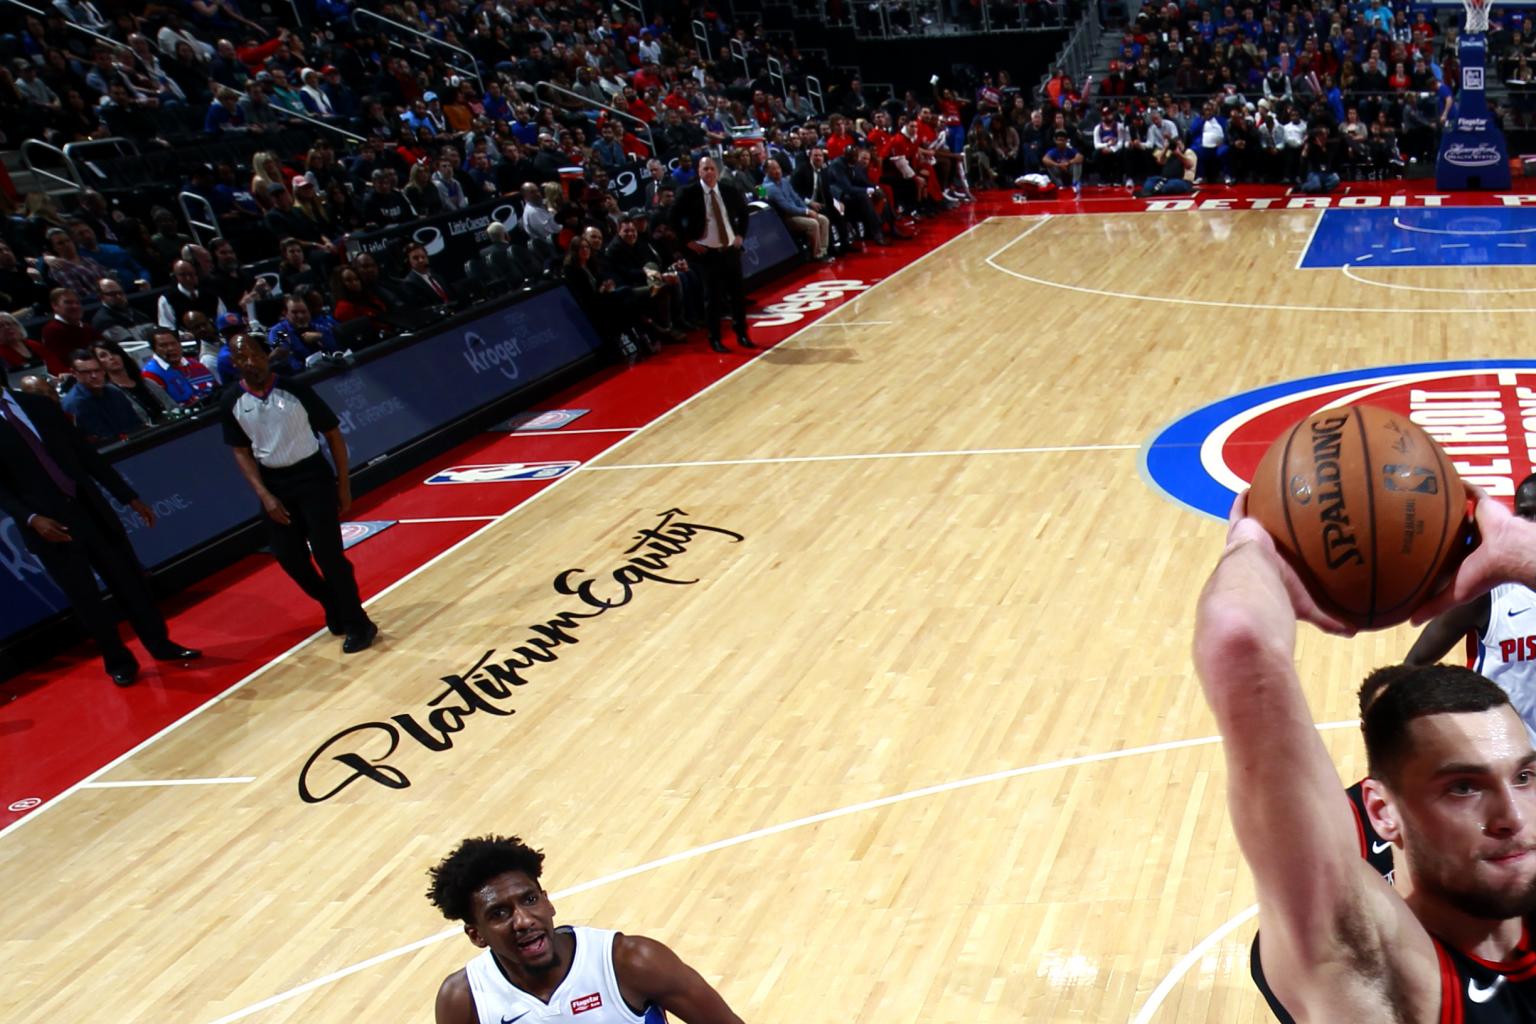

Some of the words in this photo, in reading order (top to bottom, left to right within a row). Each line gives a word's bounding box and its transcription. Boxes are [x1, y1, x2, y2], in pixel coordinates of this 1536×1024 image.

[1145, 194, 1451, 211] DETROIT
[463, 331, 523, 380] Kroger
[1311, 414, 1365, 570] SPALDING
[299, 611, 593, 804] Platinum
[553, 507, 745, 609] Equity
